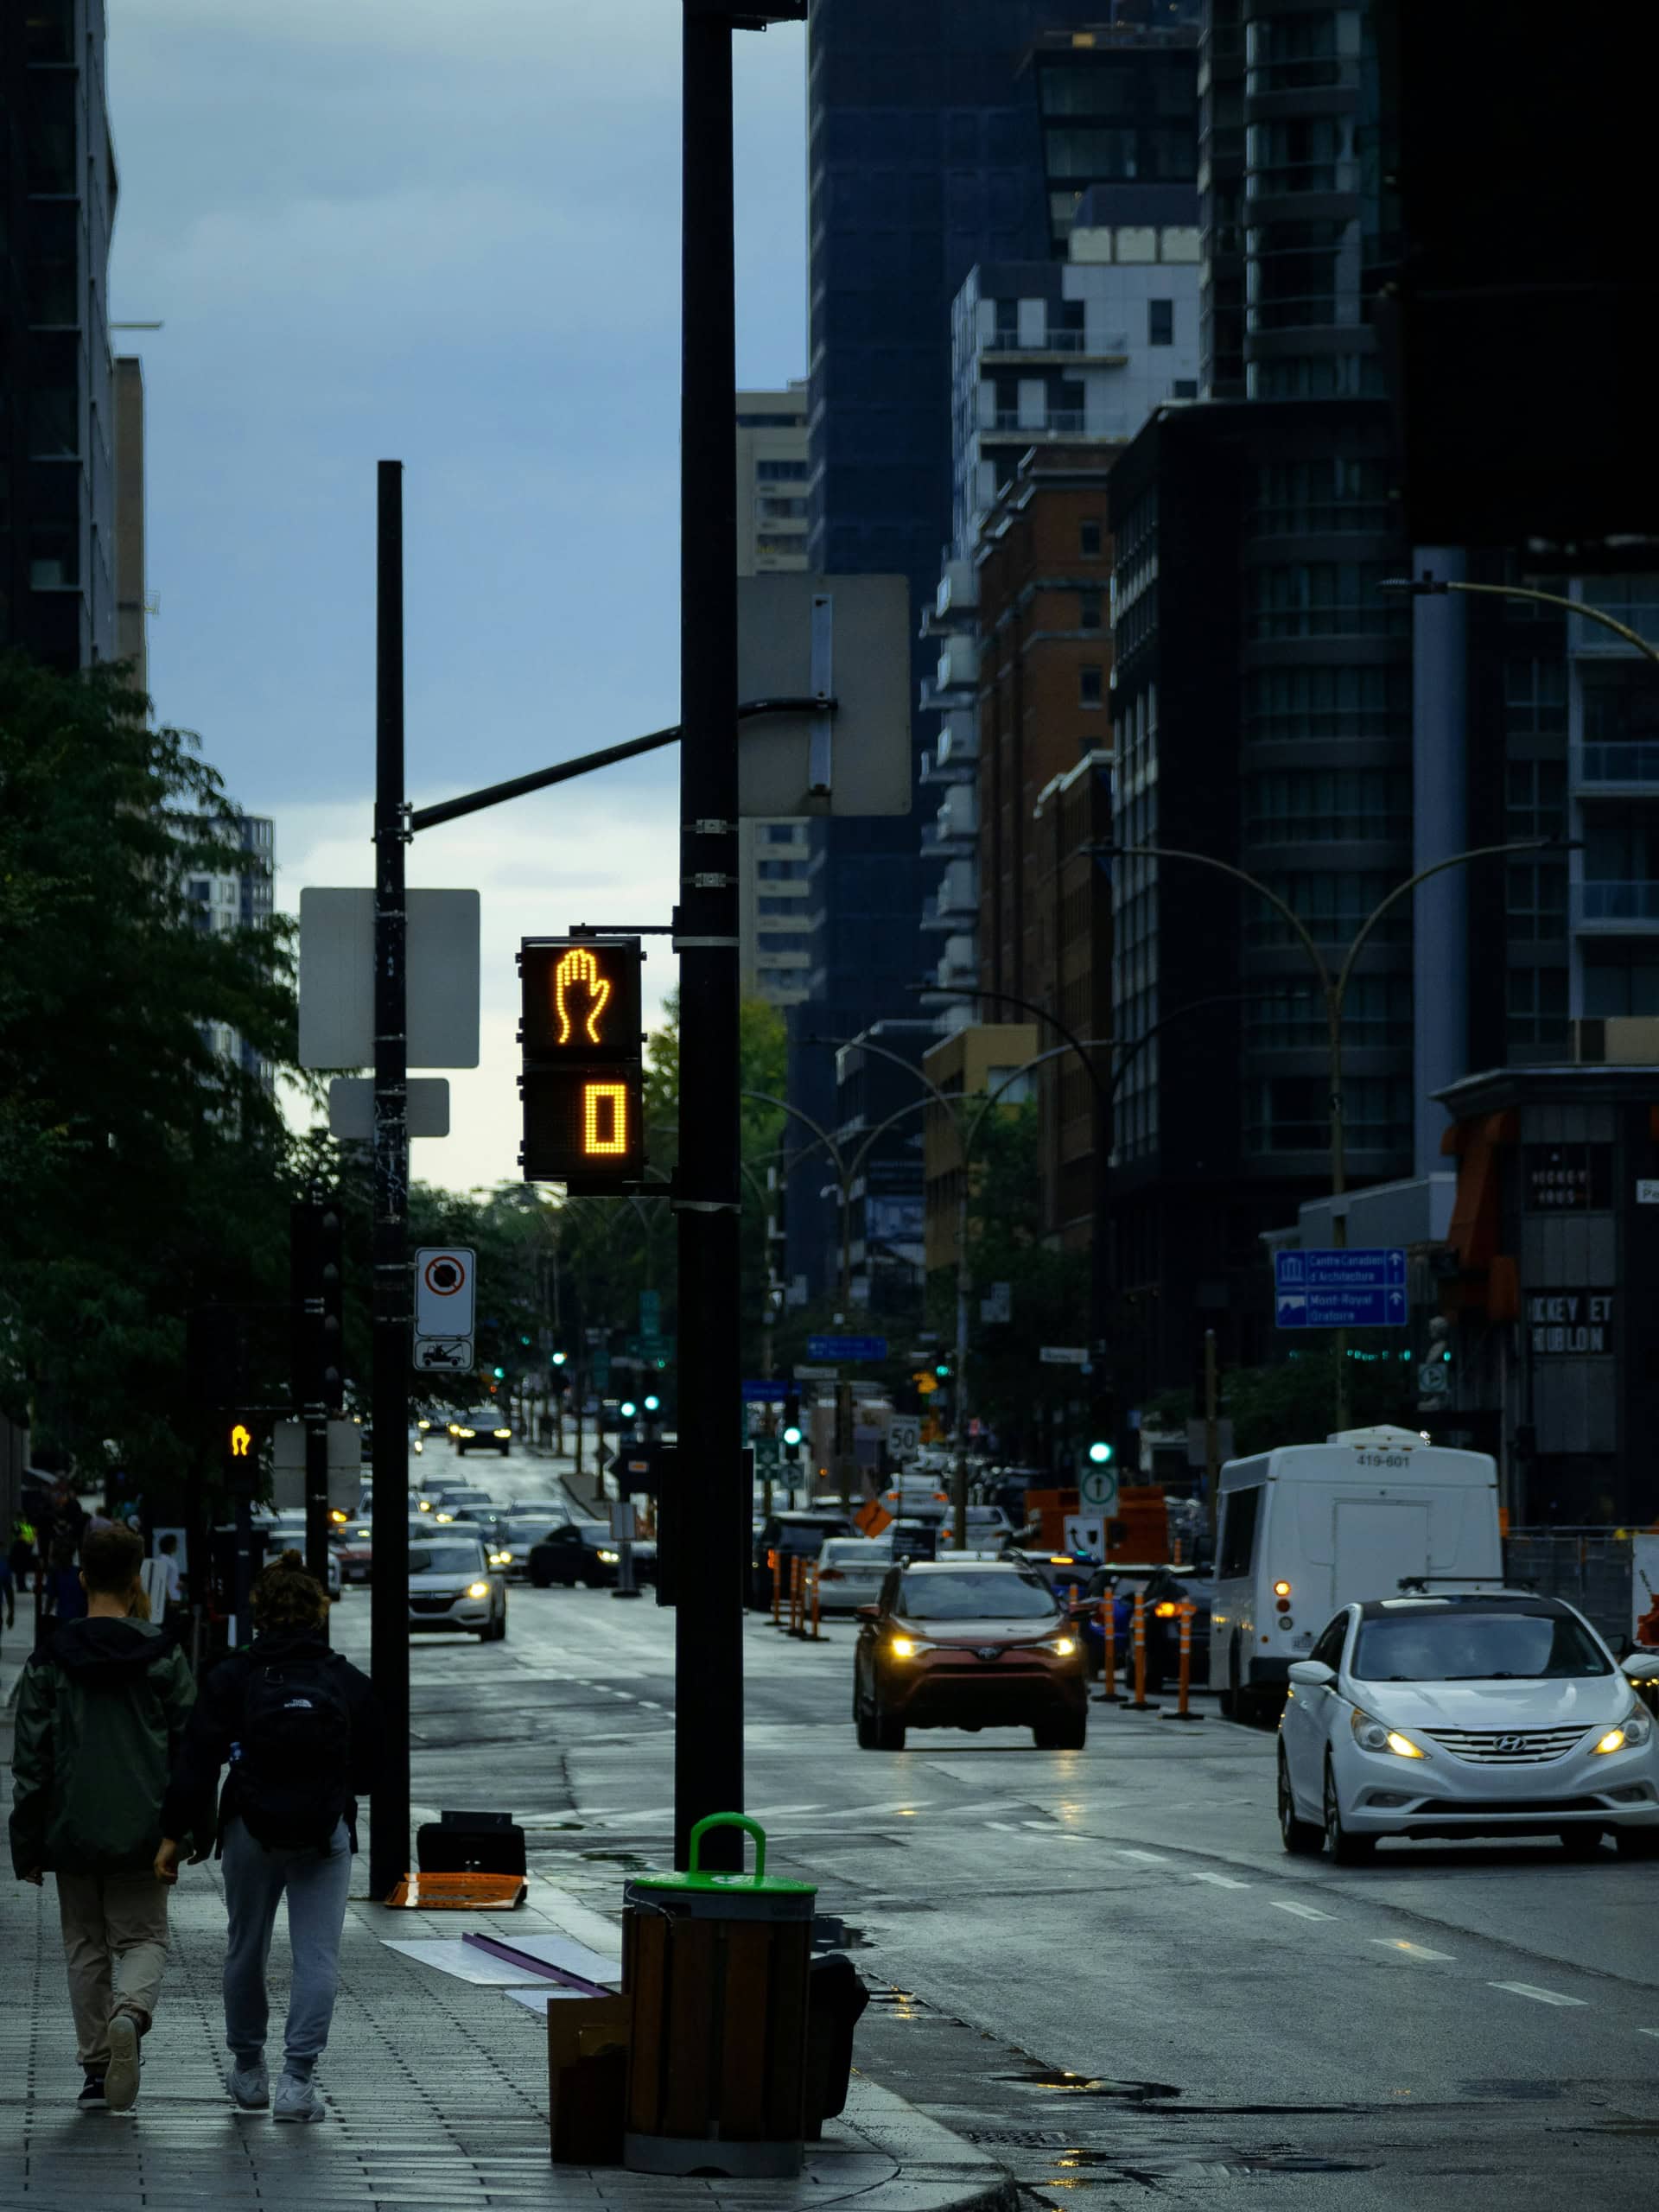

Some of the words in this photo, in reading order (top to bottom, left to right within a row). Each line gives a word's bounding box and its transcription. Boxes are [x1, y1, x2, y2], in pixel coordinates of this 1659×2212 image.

[584, 1084, 626, 1154] 0
[1310, 1292, 1374, 1307] Mont-Royal
[1311, 1309, 1356, 1322] Oratoire
[891, 1427, 916, 1450] 50
[1357, 1454, 1410, 1468] 419-601
